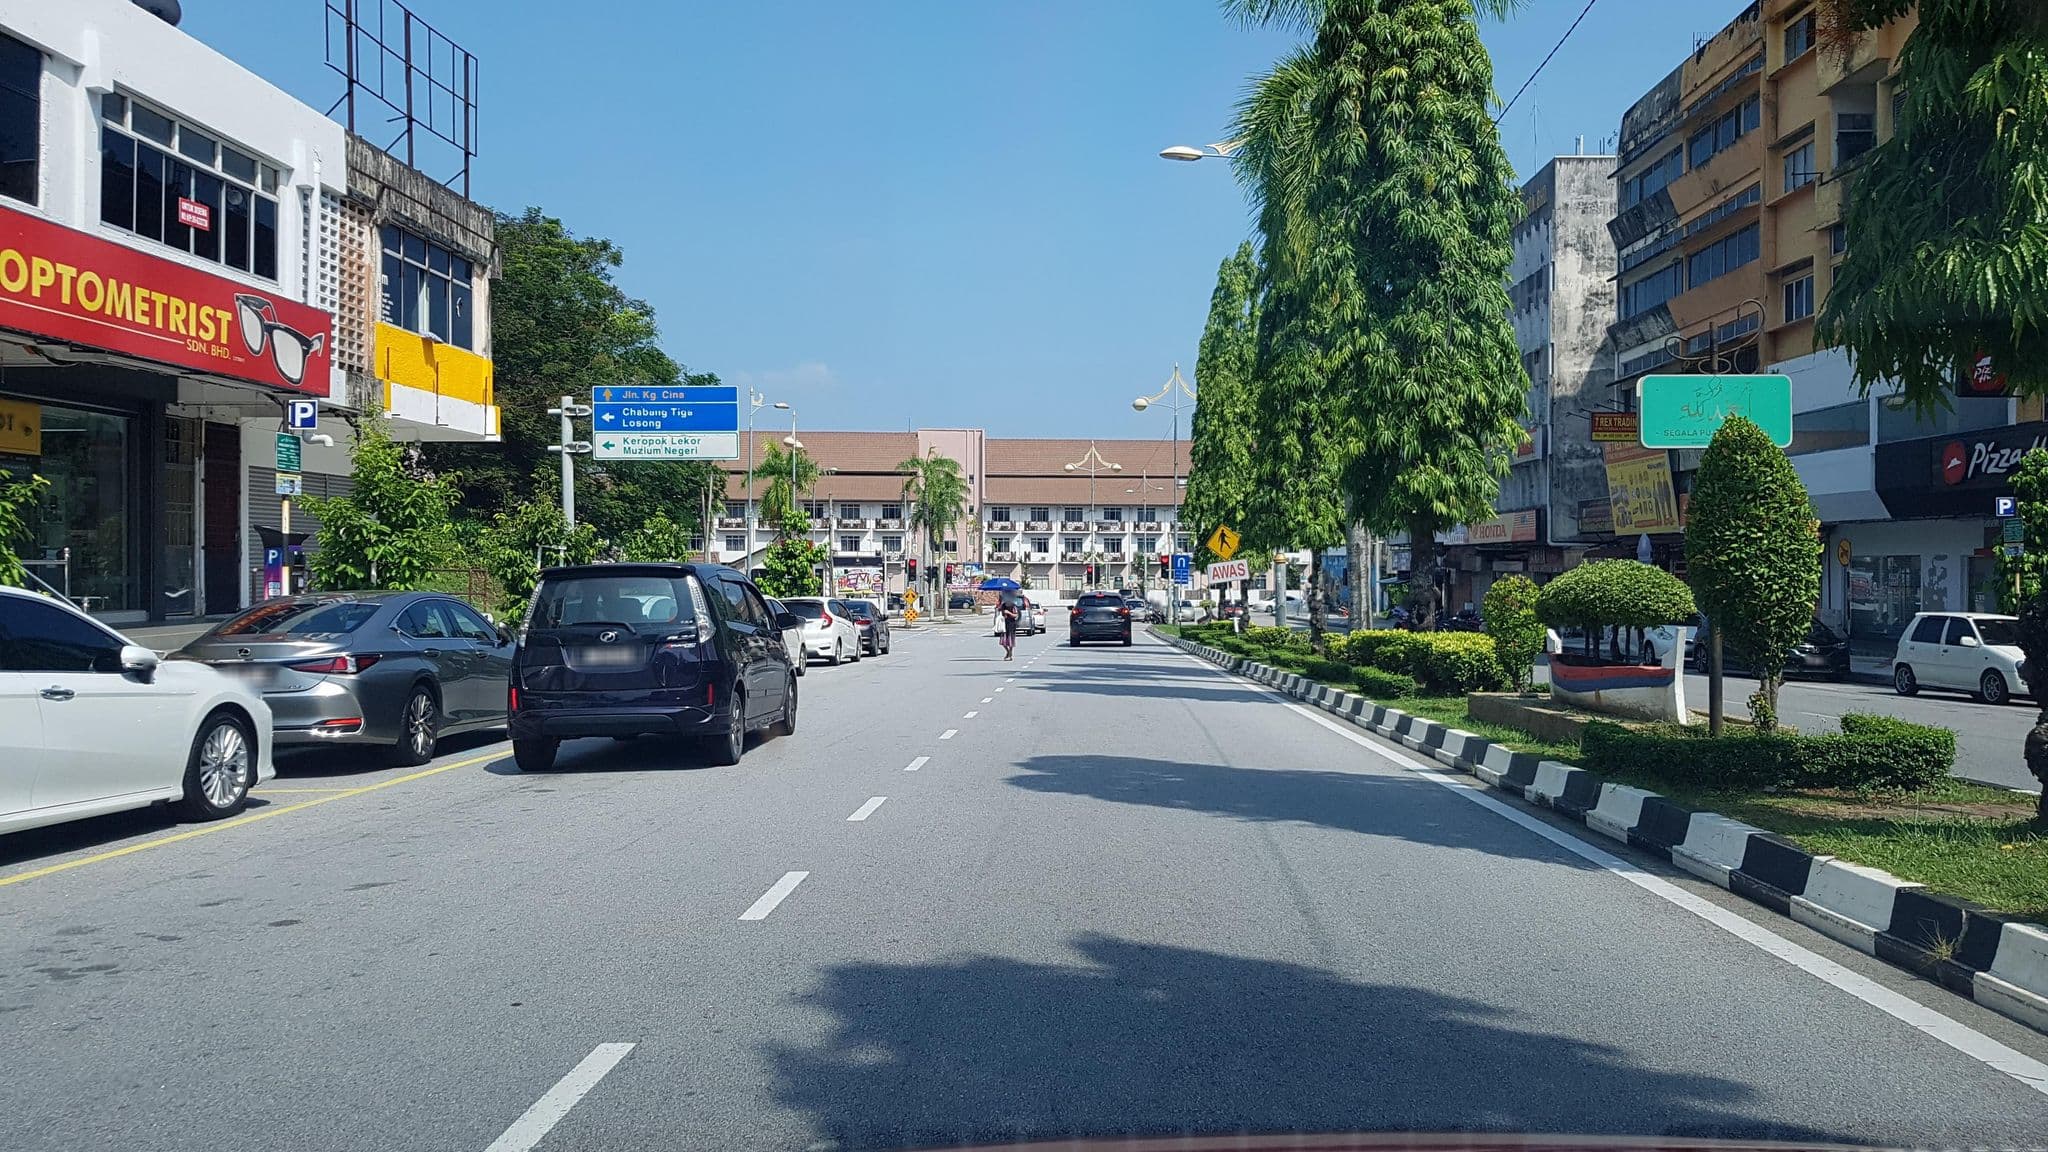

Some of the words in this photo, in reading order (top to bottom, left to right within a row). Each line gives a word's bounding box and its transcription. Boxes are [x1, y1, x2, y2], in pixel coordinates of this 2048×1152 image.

[0, 249, 232, 344] OPTOMETRIST
[186, 338, 208, 354] SDN.
[211, 344, 231, 360] BHD.
[643, 391, 657, 401] Kg
[662, 391, 685, 399] Cina
[295, 403, 313, 427] P
[671, 407, 693, 418] Tiga
[622, 419, 661, 429] Losong
[1613, 417, 1637, 428] TRADIN
[1664, 429, 1697, 437] SEGALA
[1700, 429, 1714, 437] PU
[623, 437, 667, 446] Keropok
[671, 437, 702, 445] Lekor
[623, 446, 661, 455] Muzium
[664, 446, 698, 456] Negeri
[1968, 441, 2021, 479] Pizza
[1999, 500, 2012, 515] P
[1479, 523, 1507, 538] HONDA
[1212, 563, 1246, 580] AWAS
